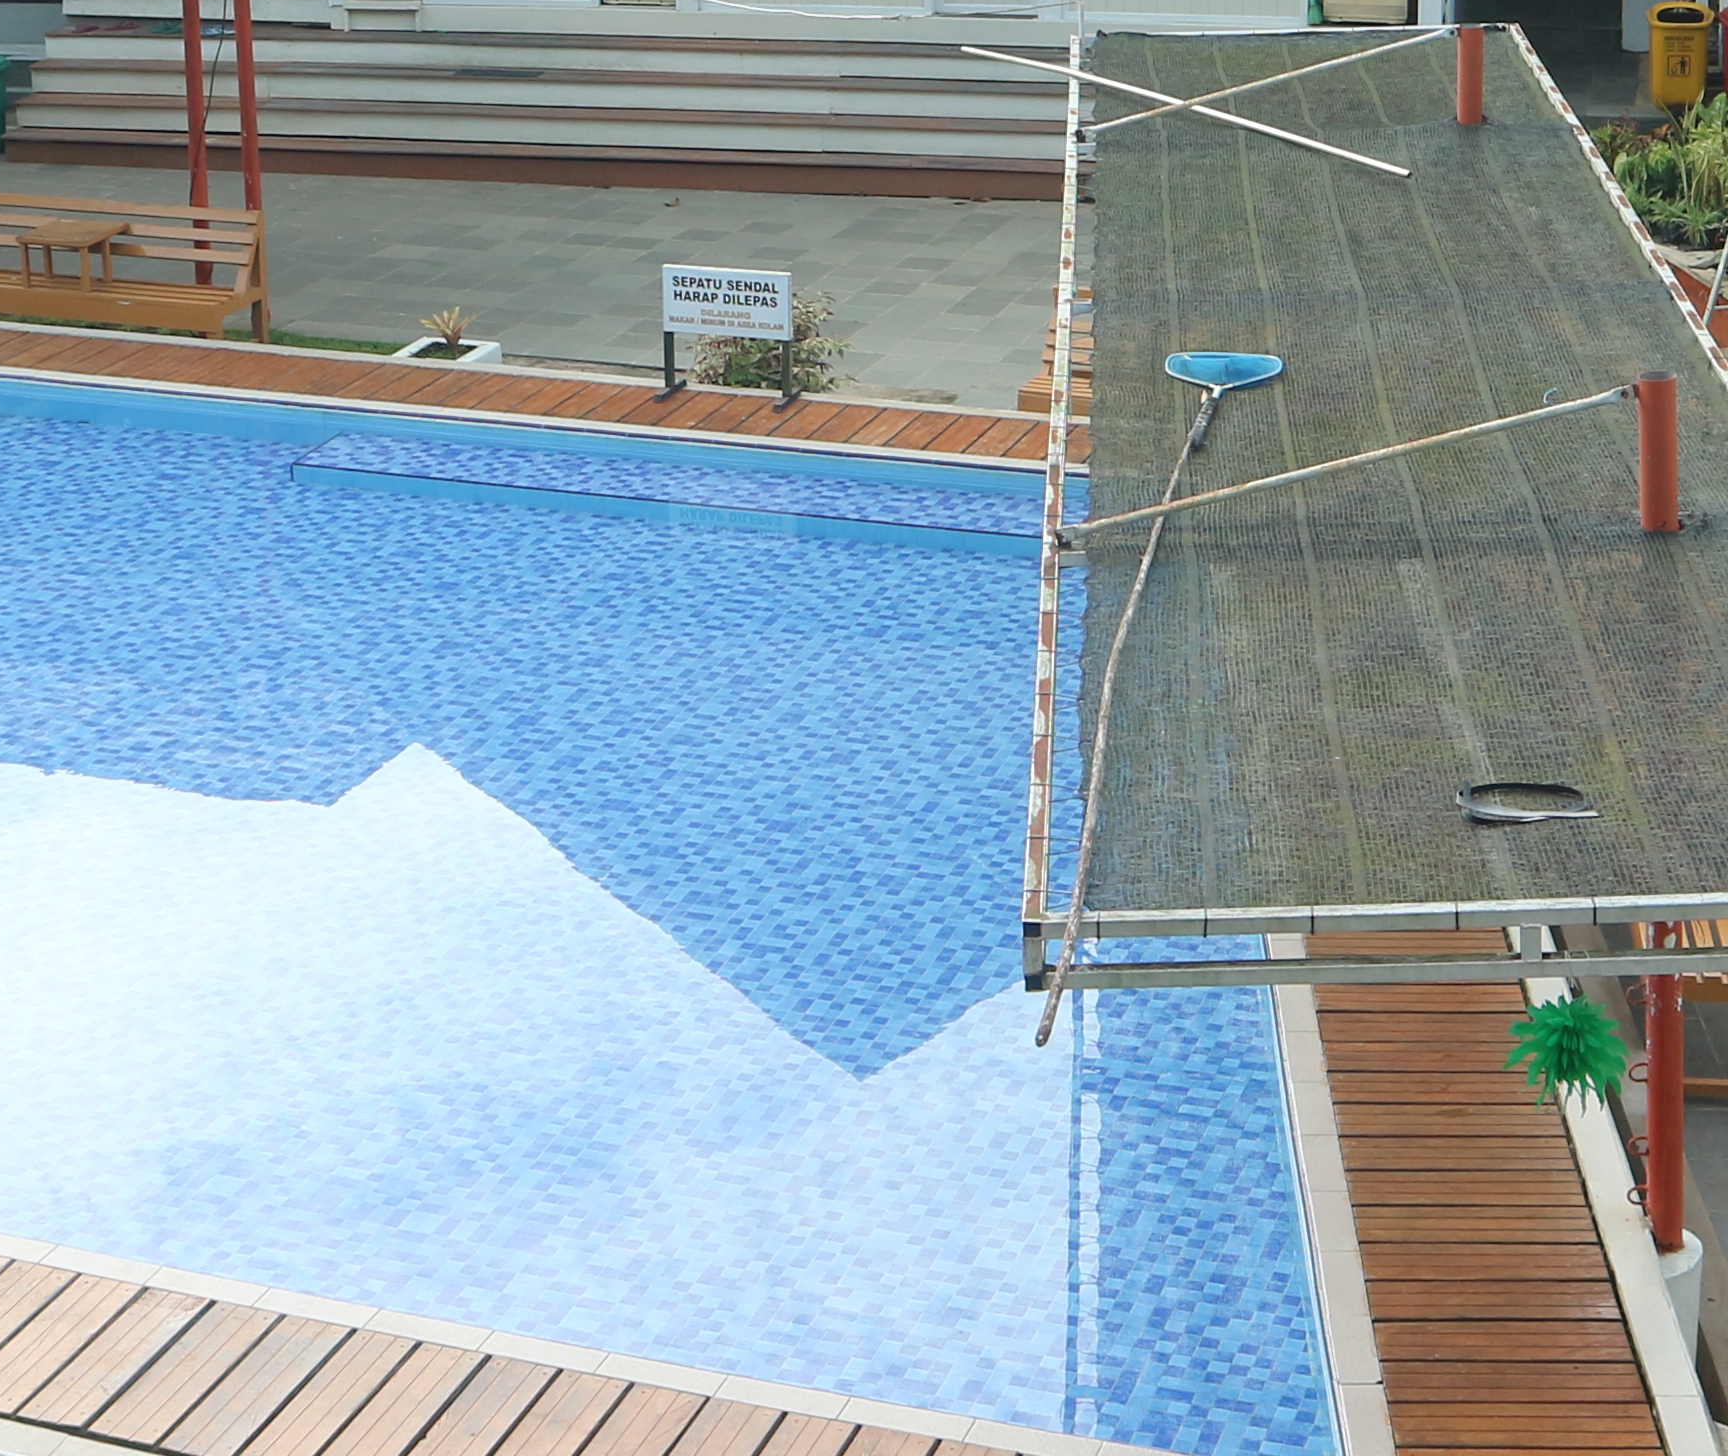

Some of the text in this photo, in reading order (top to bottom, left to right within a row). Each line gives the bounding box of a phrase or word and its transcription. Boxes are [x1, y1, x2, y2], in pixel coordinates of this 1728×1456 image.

[672, 275, 779, 294] SEPATU SENDAL
[674, 290, 778, 308] HARAP DILEPAS
[700, 308, 751, 320] DILARANG
